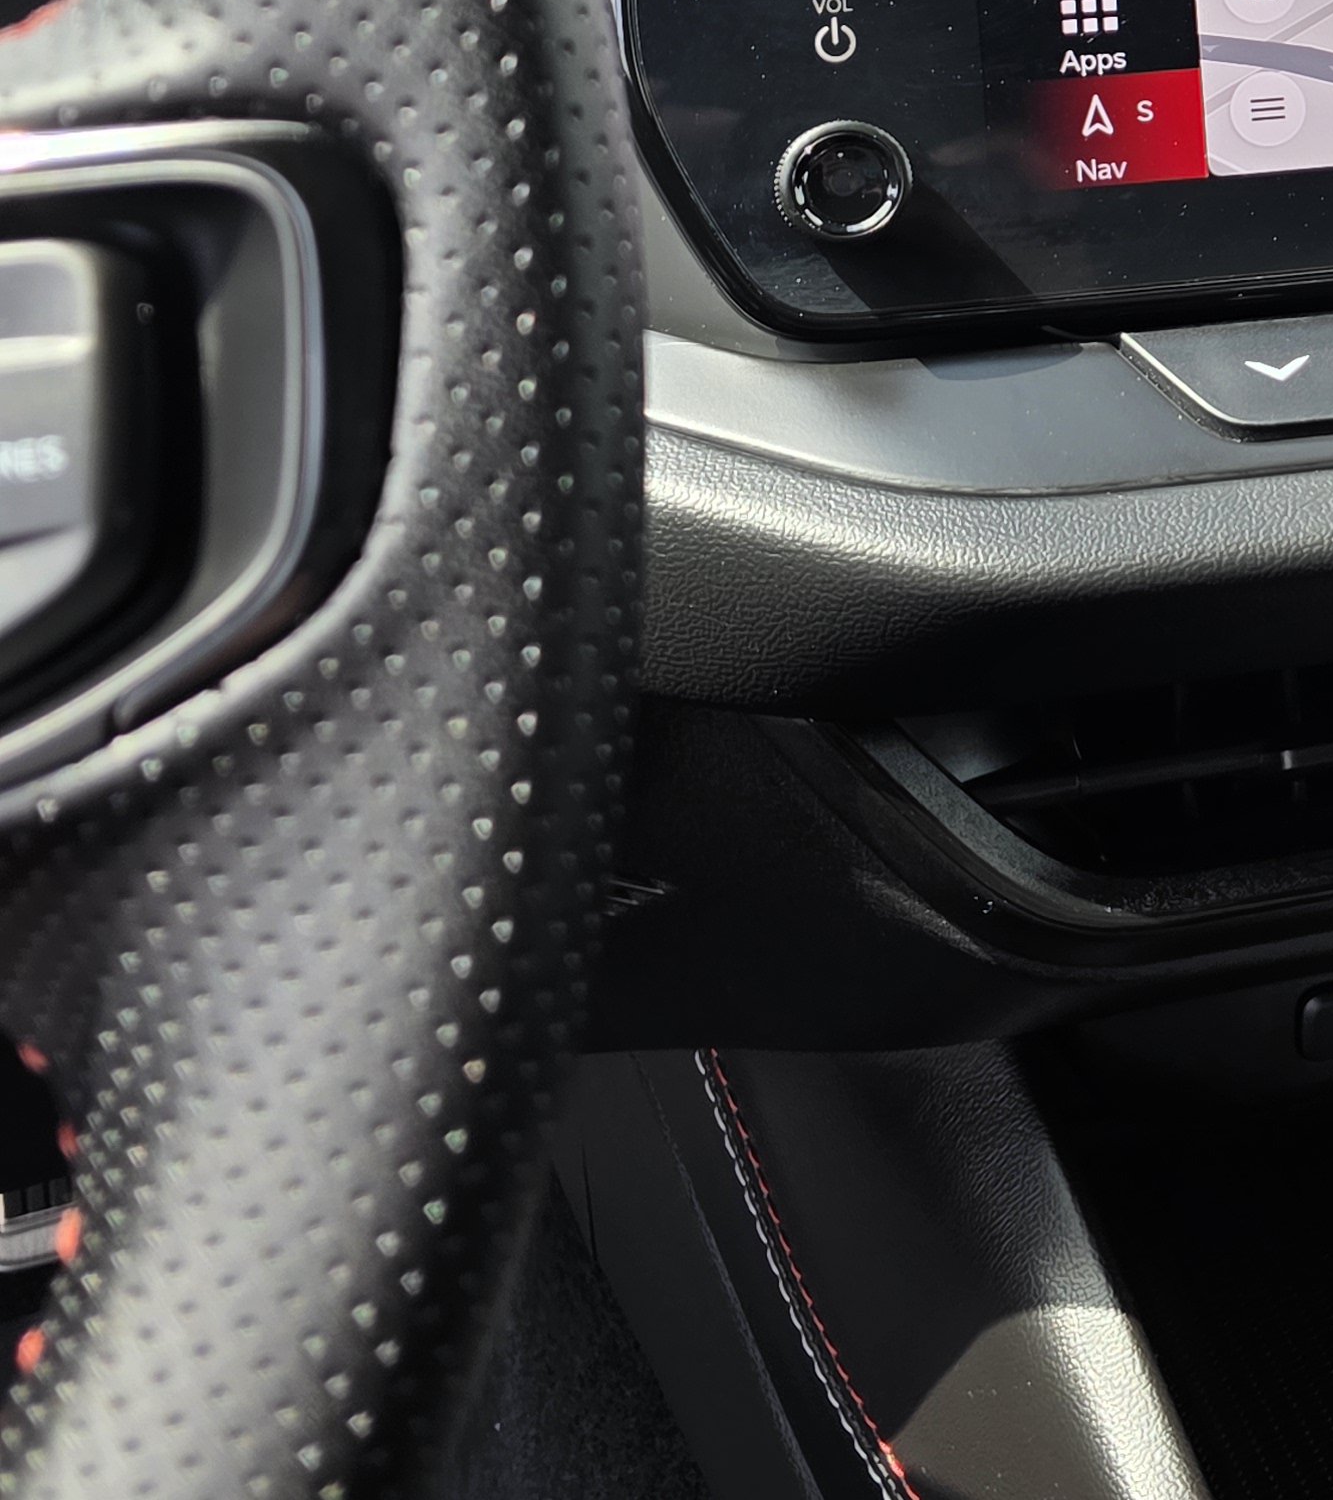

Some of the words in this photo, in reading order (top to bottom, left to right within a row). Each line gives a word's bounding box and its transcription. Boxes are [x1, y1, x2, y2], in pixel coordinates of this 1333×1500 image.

[1059, 49, 1127, 76] Apps
[1136, 100, 1154, 121] S
[1076, 158, 1127, 182] Nav
